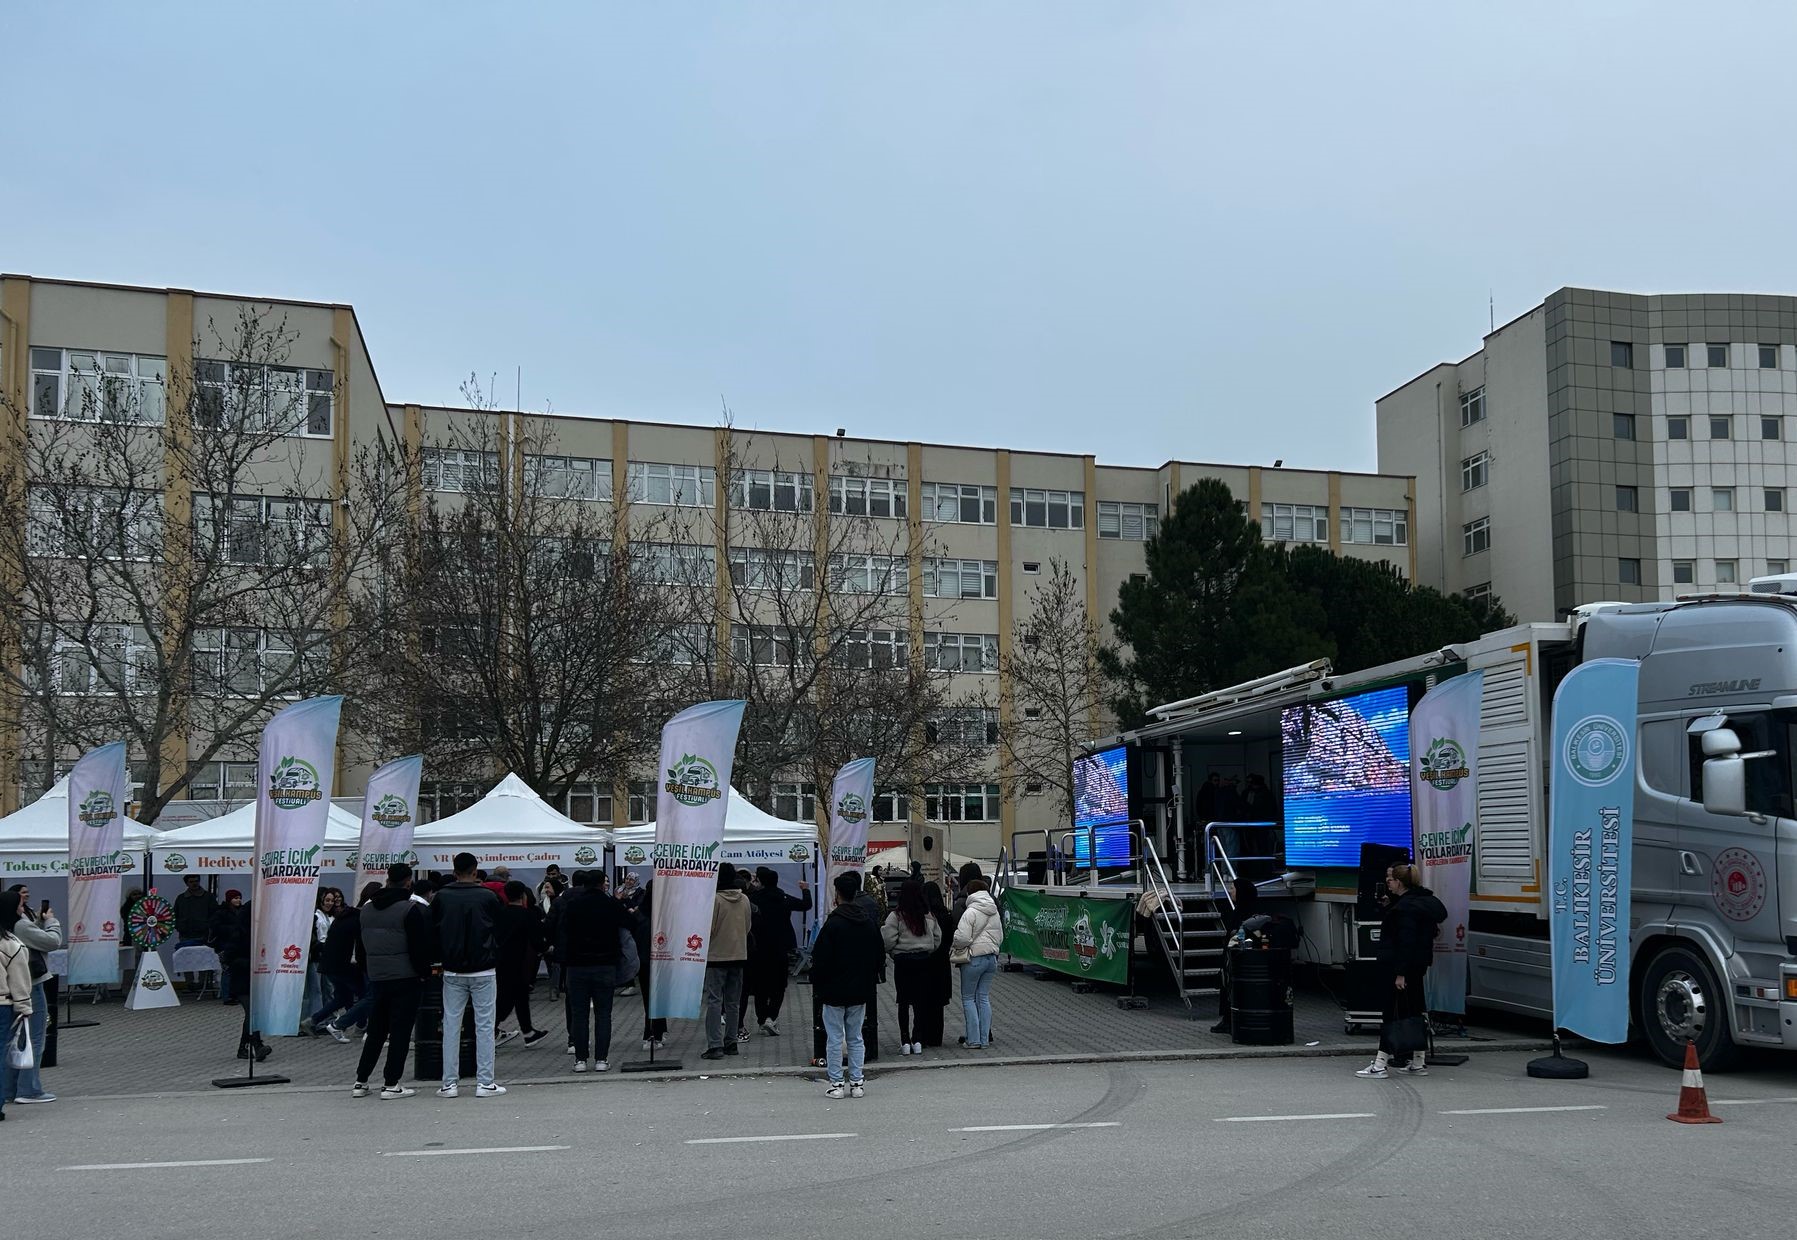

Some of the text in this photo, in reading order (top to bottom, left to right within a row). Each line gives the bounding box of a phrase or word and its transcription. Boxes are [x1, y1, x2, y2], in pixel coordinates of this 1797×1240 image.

[1688, 678, 1761, 696] STREAMLINE
[433, 854, 449, 863] VR
[526, 852, 561, 863] Çadırı
[720, 850, 742, 859] Cam
[744, 849, 783, 859] Atölyesi
[3, 860, 48, 873] Tokuş
[198, 856, 247, 870] Hediye
[653, 858, 719, 872] YOLLARDAYIZ
[1555, 878, 1568, 913] T.C.
[1570, 828, 1592, 964] BALIKESİR
[1594, 807, 1620, 986] ÜNİVERSİTESİ
